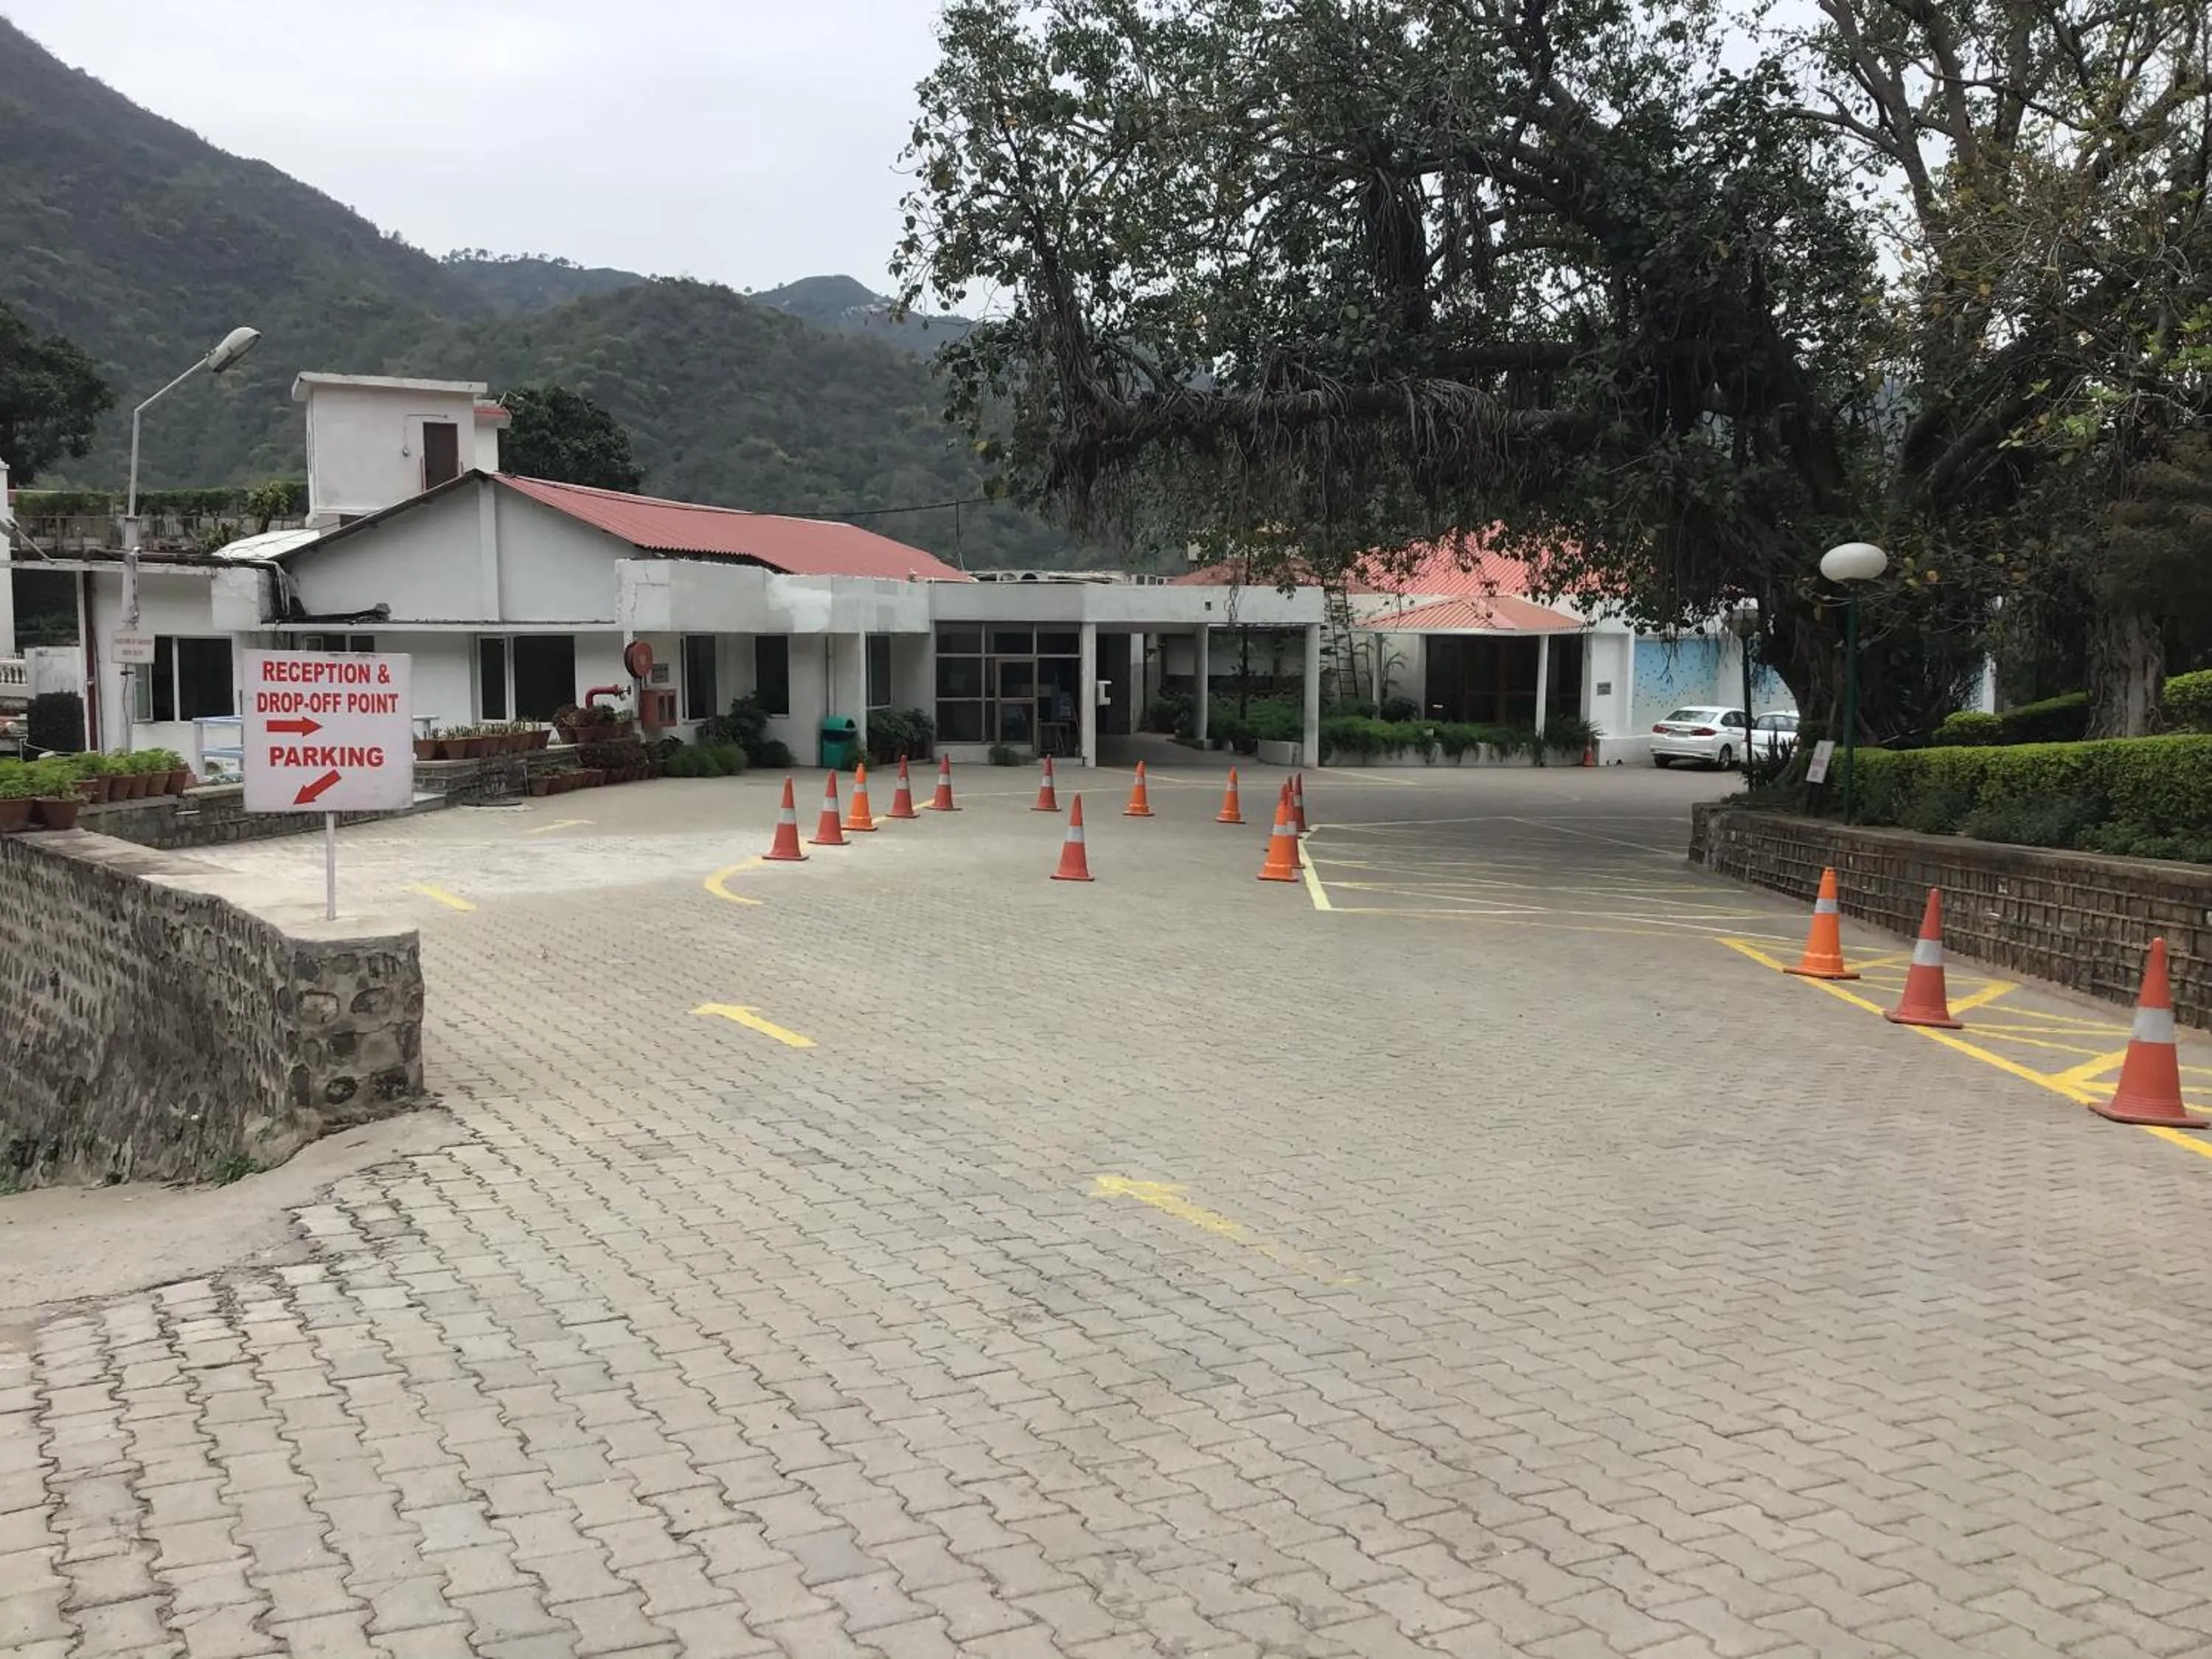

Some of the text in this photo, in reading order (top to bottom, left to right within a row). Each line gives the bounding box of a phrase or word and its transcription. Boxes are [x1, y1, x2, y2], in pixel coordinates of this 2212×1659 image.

[262, 661, 390, 684] RECEPTION &
[257, 692, 399, 713] DROP-OFF POINT
[269, 746, 384, 767] PARKING
